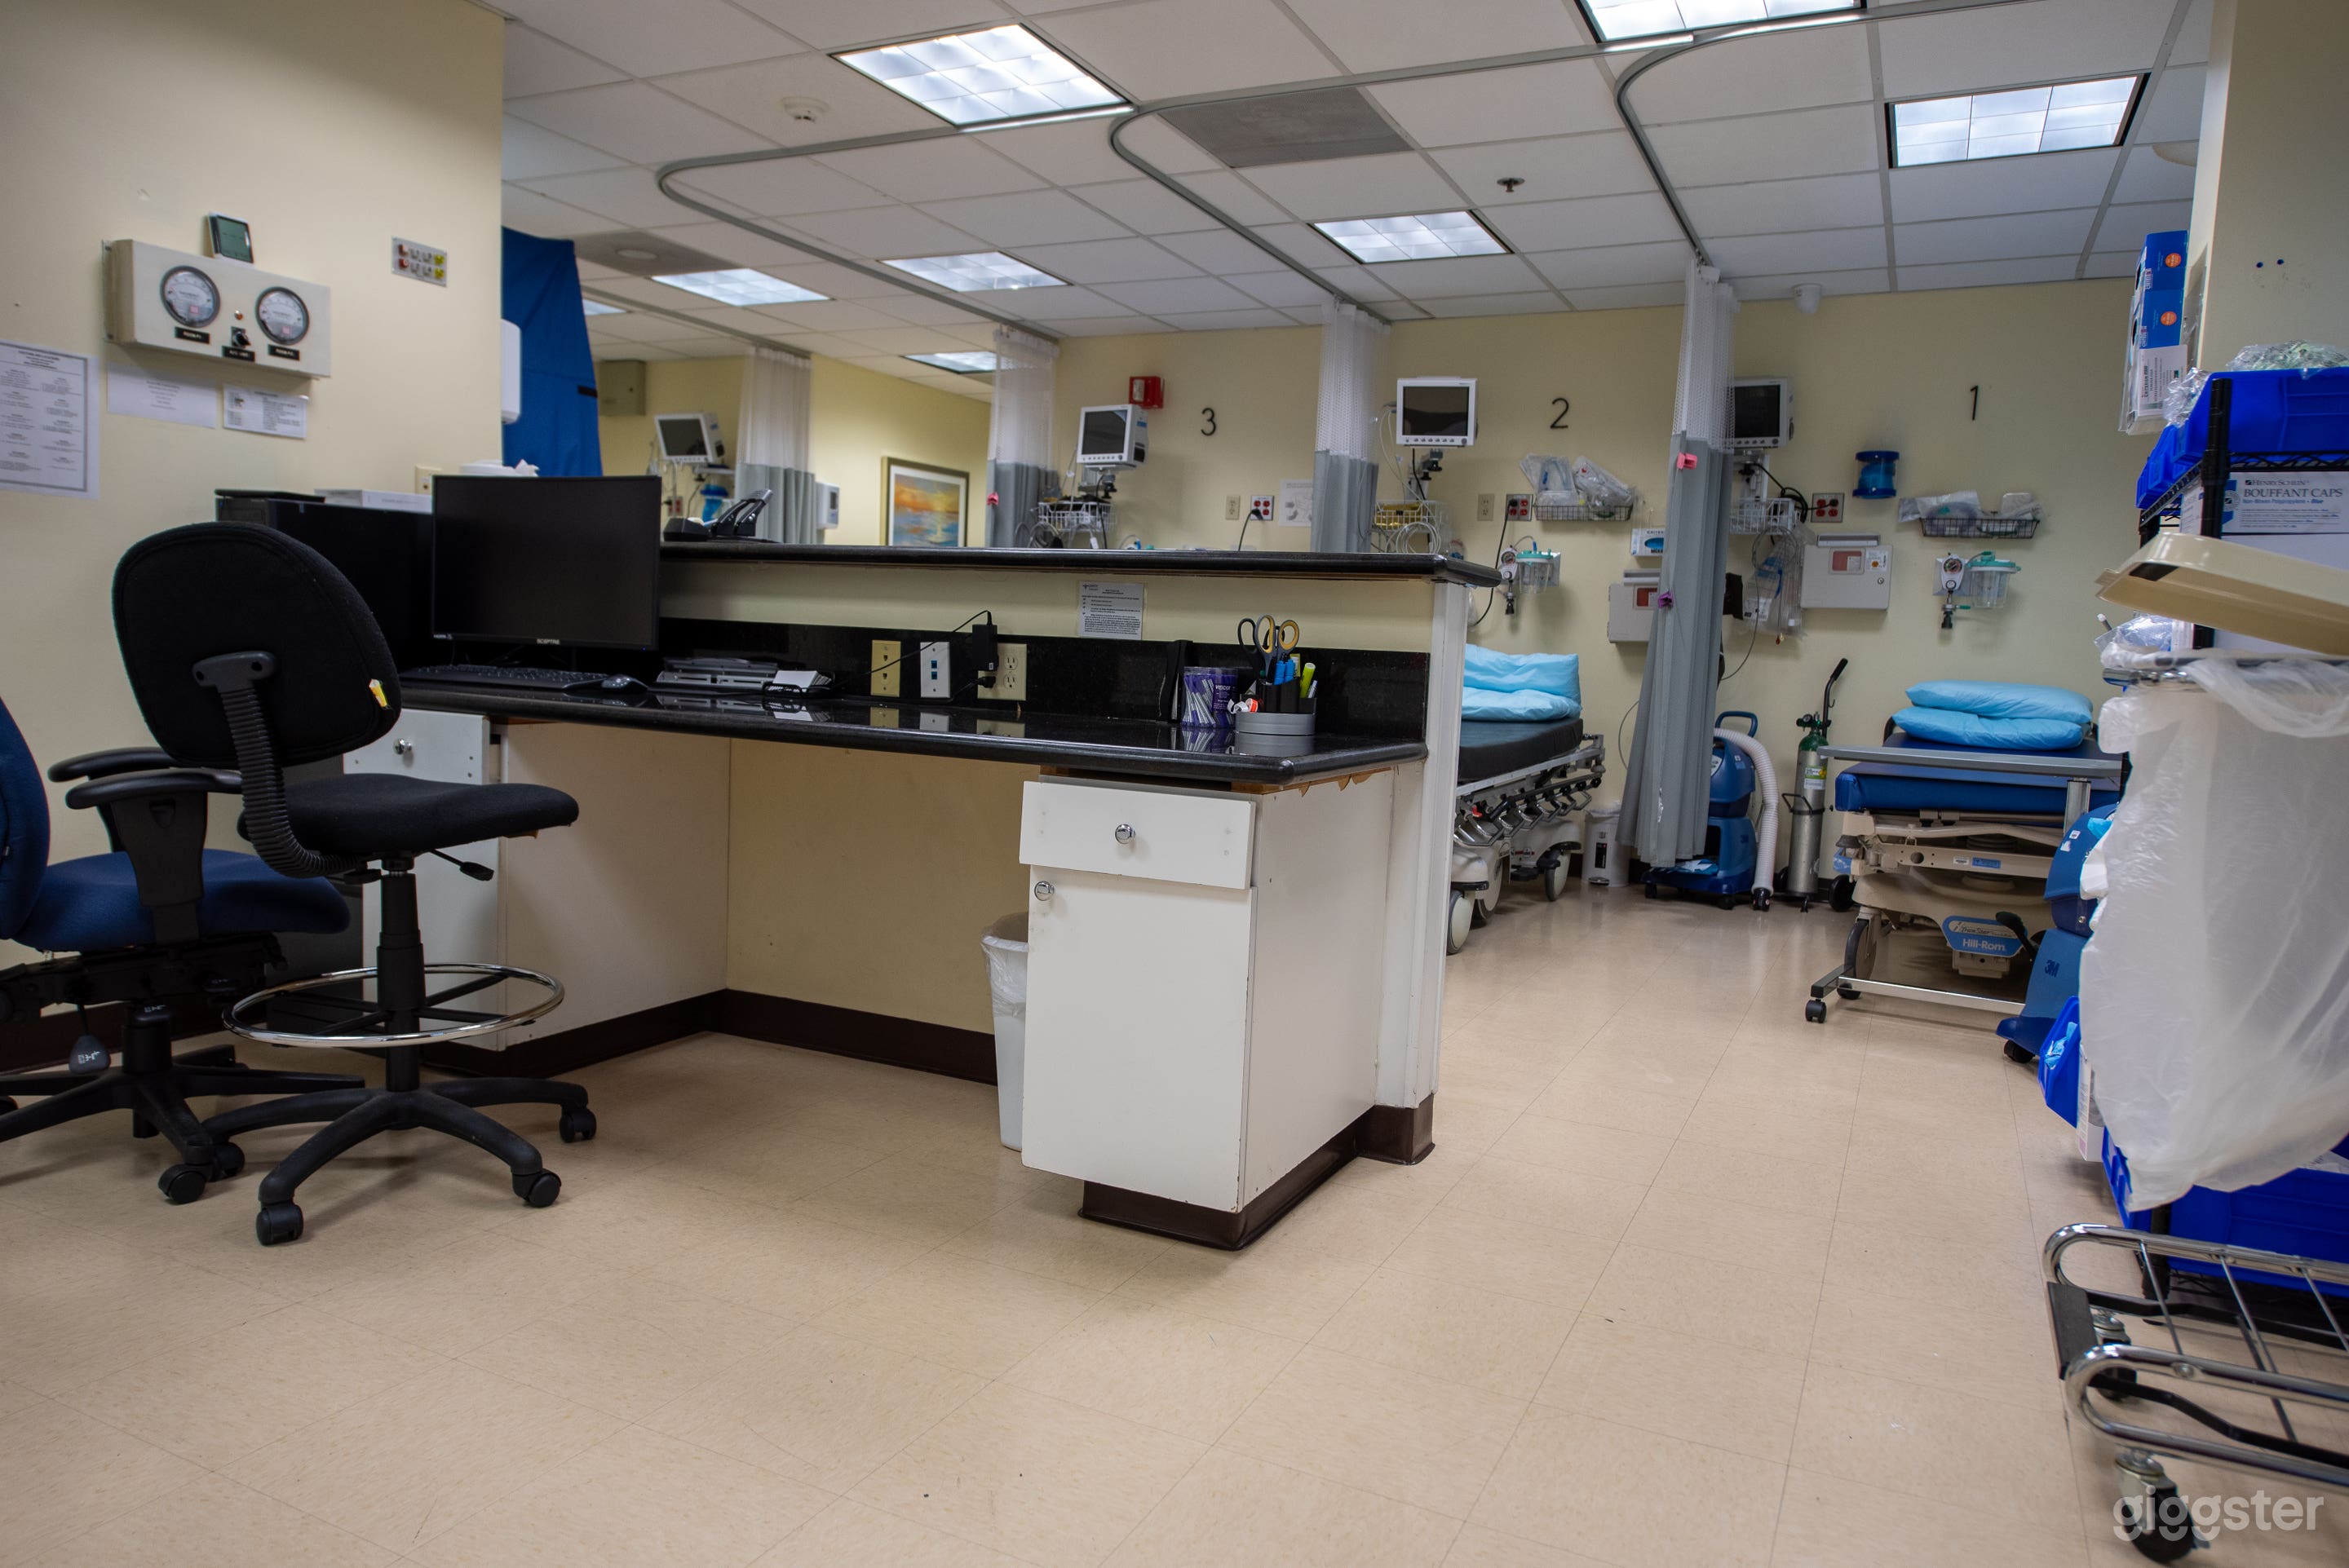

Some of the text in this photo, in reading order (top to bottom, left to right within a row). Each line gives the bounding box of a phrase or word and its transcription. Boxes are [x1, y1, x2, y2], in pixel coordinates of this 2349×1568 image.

[1551, 398, 1569, 429] 2
[1971, 385, 1979, 421] 1
[1201, 408, 1216, 436] 3
[2244, 488, 2343, 497] BOUFFANT CAPS
[1962, 939, 2006, 952] Hill-Rom
[2045, 960, 2060, 978] 3M
